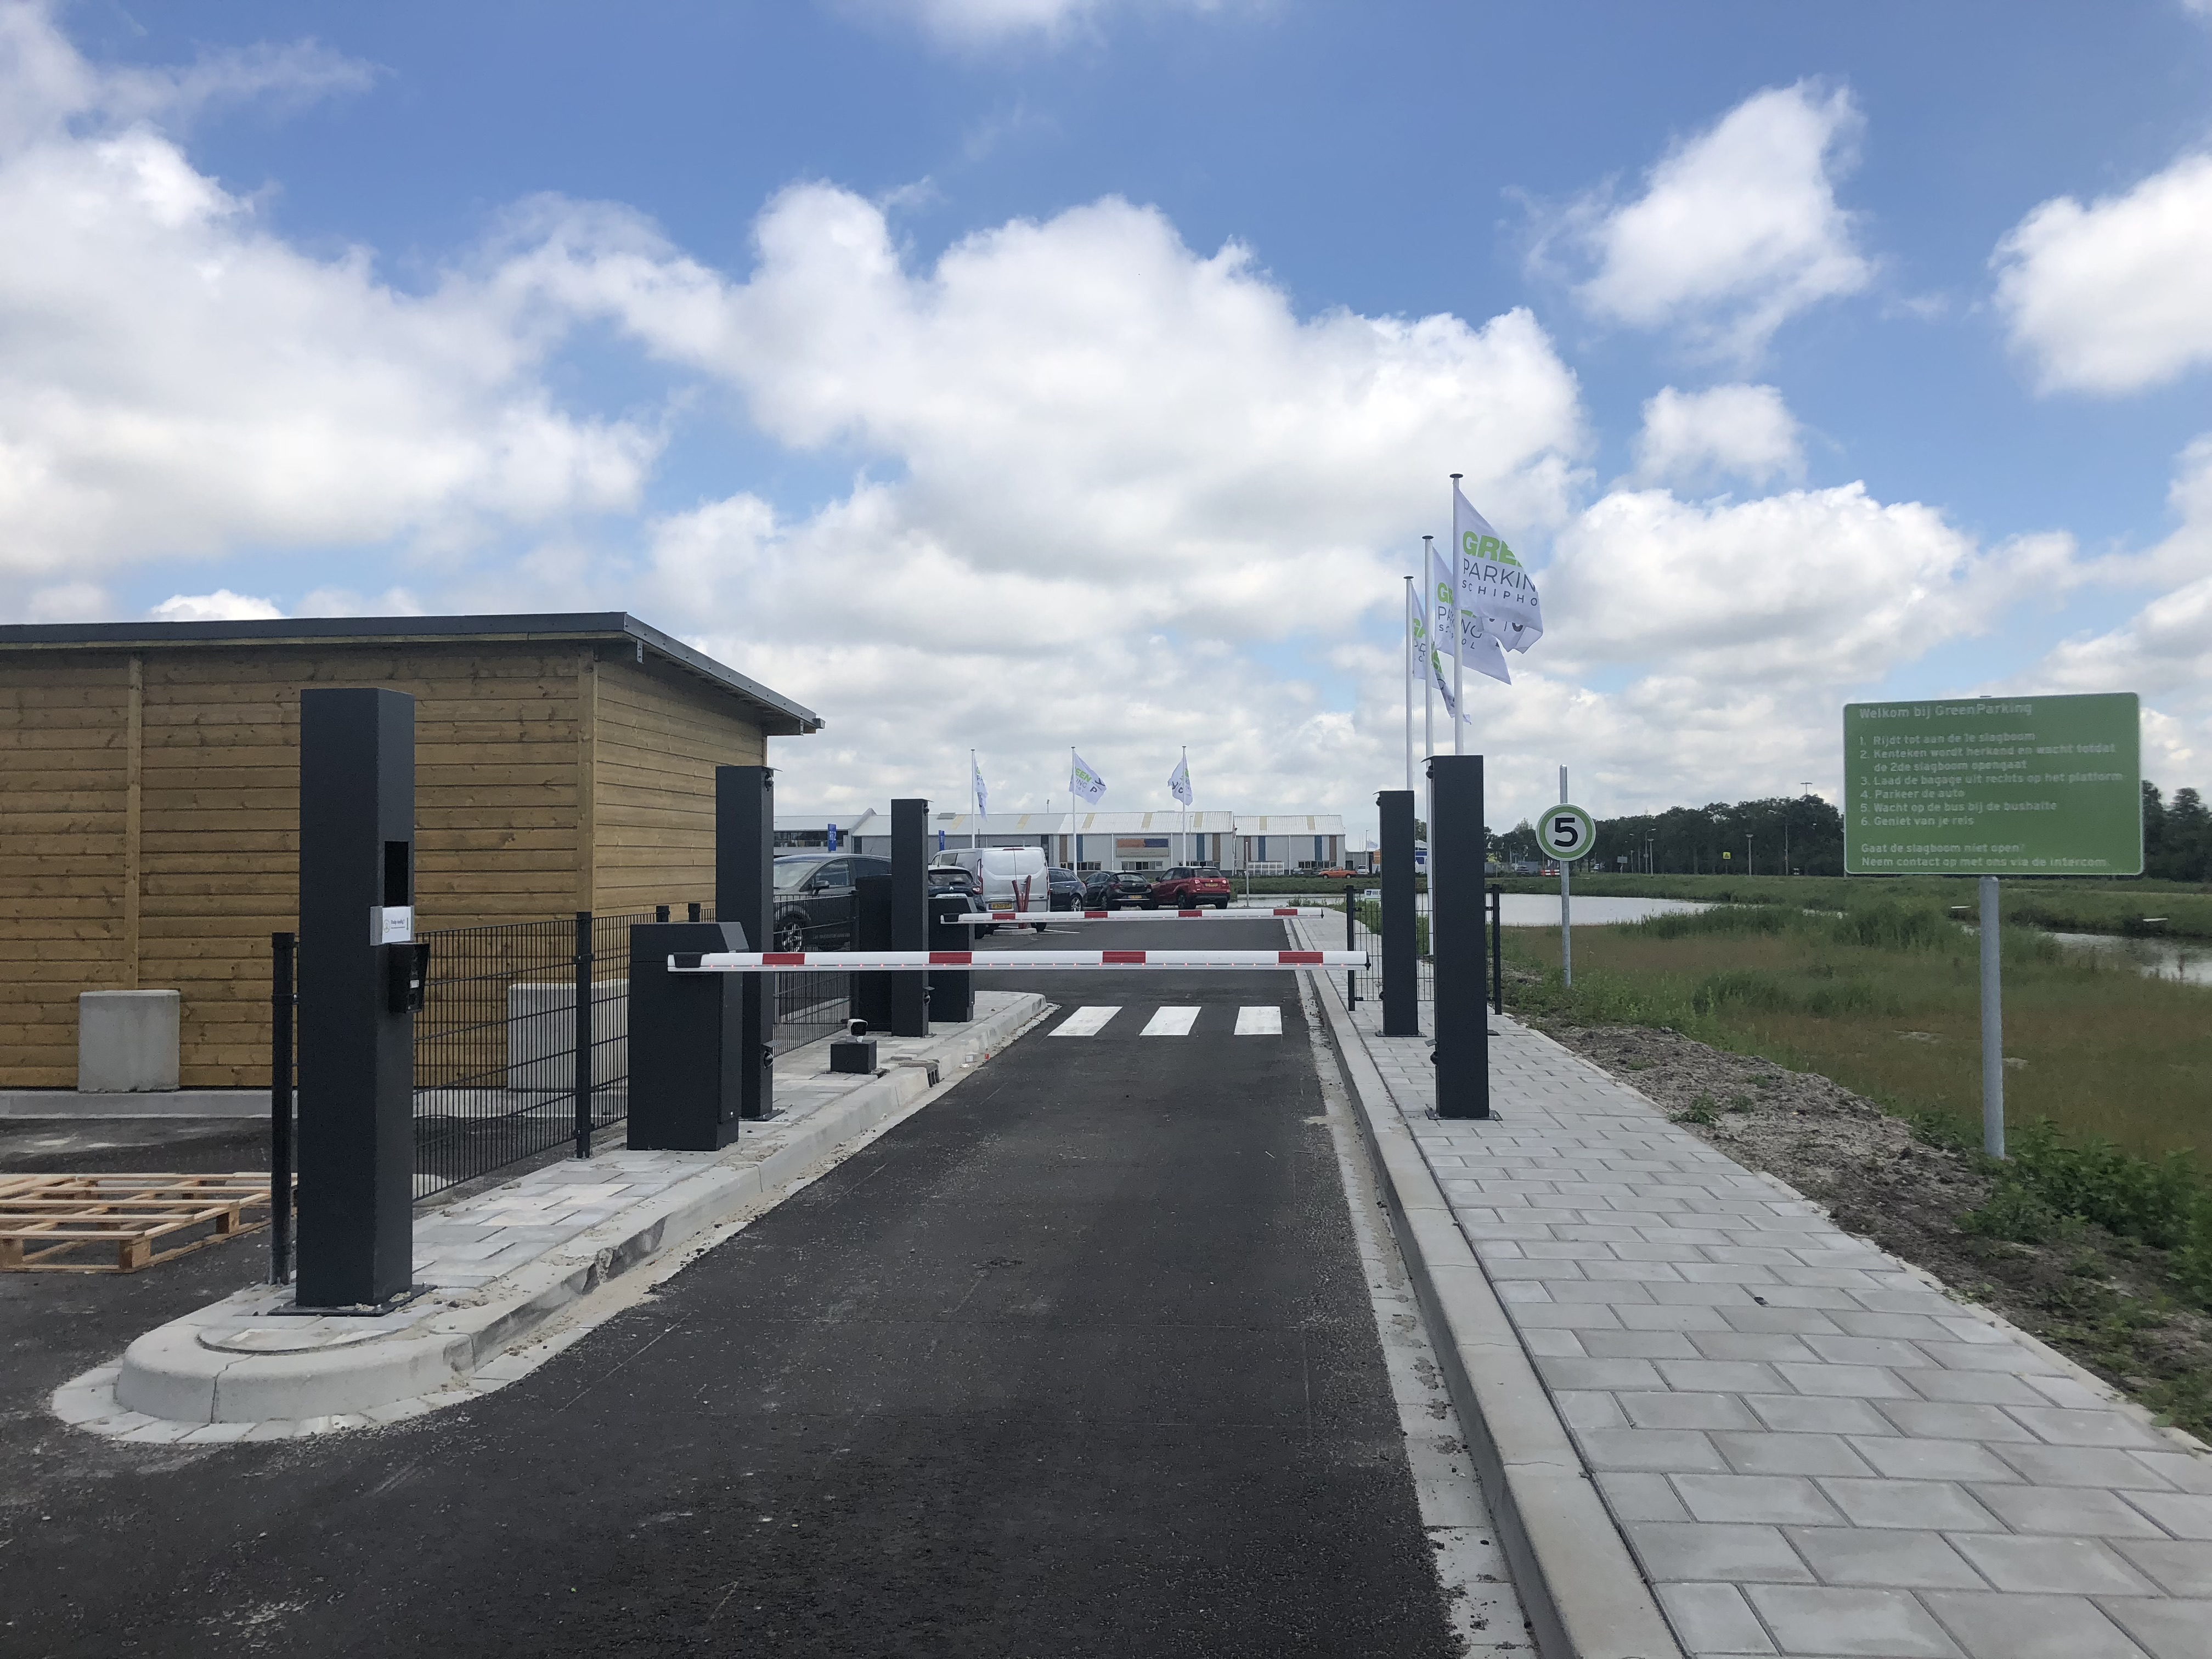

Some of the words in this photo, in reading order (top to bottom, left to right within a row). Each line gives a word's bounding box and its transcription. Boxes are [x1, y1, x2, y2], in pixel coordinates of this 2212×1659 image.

[1463, 531, 1522, 568] GRE
[1463, 557, 1536, 592] PARKIN
[1462, 579, 1538, 606] SCHIPHO
[1859, 707, 1910, 719] Welkom
[1914, 706, 1931, 719] bij
[1874, 735, 1901, 747] Rijdt
[1904, 735, 1920, 744] tot
[1948, 733, 1962, 743] de
[1978, 732, 2035, 744] slagboom
[1860, 750, 1870, 759] 2.
[1874, 749, 1927, 758] Kenteken
[1931, 747, 1963, 757] wordt
[1966, 746, 2014, 756] herkend
[1874, 763, 1887, 771] de
[1891, 762, 1911, 771] 2de
[1914, 761, 1968, 773] slagboom
[1860, 776, 1870, 785] 3.
[1874, 776, 1901, 785] Laad
[1905, 775, 1918, 785] de
[1921, 775, 1962, 787] bagage
[1965, 774, 1982, 783] uit
[1985, 774, 2024, 783] rechts
[2027, 775, 2041, 783] op
[2045, 772, 2065, 781] het
[1860, 789, 1872, 799] 4.
[1875, 789, 1920, 799] Parkeer
[1921, 789, 1936, 798] de
[1937, 789, 1965, 798] auto
[1860, 803, 1870, 812] 5.
[1874, 803, 1908, 812] Wacht
[1911, 804, 1925, 813] op
[1927, 803, 1941, 811] de
[1944, 802, 1965, 811] bus
[1968, 802, 1983, 814] bij
[1986, 802, 2000, 811] de
[1861, 816, 1871, 826] 6.
[1874, 816, 1911, 826] Geniet
[1914, 817, 1935, 826] van
[1938, 816, 1950, 828] je
[1952, 816, 1974, 825] reis
[1554, 817, 1578, 847] 5
[1861, 843, 1887, 853] Gaat
[1891, 843, 1904, 853] de
[1906, 843, 1961, 855] slagboom
[1964, 843, 1988, 853] niet
[1861, 856, 1893, 866] Neem
[1897, 857, 1940, 866] contact
[1943, 859, 1957, 868] op
[1960, 857, 1983, 866] met
[1986, 858, 2007, 866] ons
[2010, 857, 2029, 866] via
[2032, 857, 2047, 866] de
